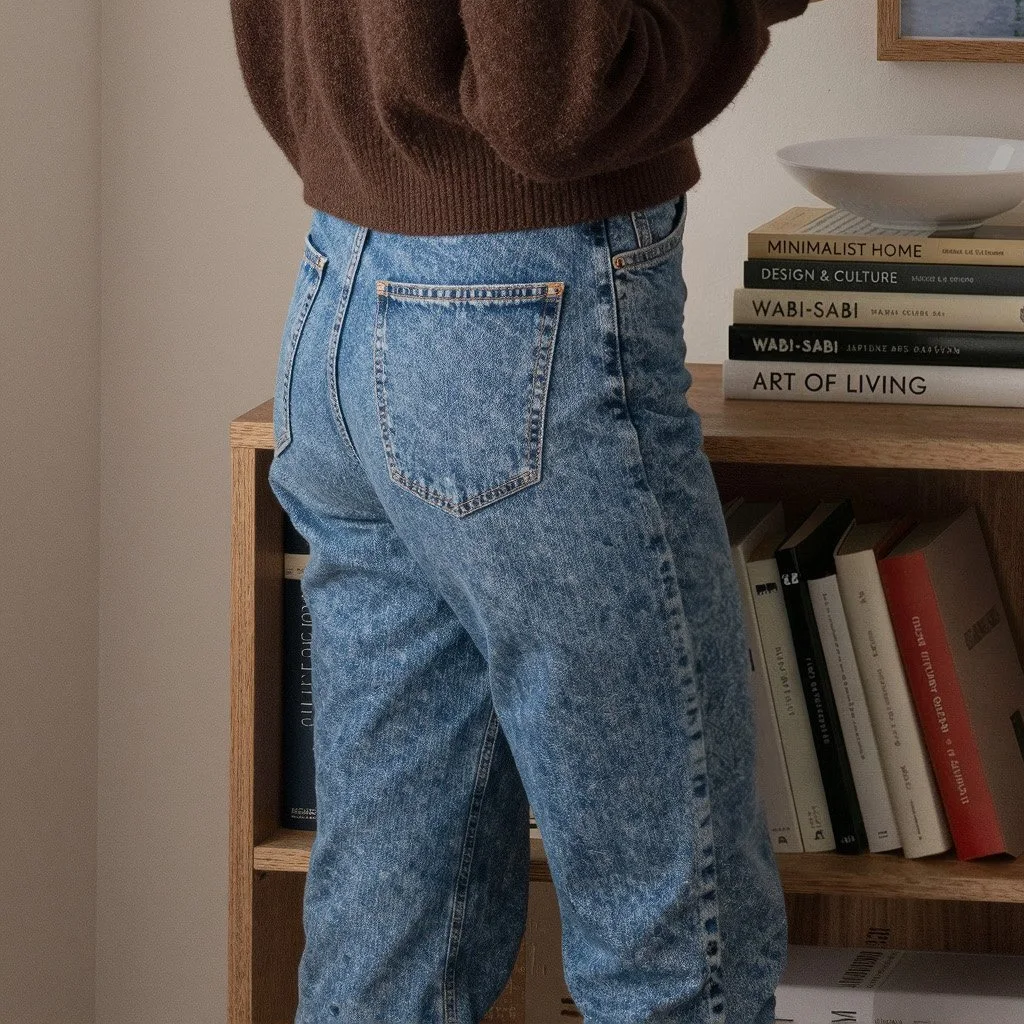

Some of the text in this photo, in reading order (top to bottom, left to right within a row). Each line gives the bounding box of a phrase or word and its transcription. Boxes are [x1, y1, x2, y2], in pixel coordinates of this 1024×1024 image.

[768, 240, 922, 258] MINIMALIST HOME
[761, 268, 815, 281] DESIGN
[819, 269, 830, 282] &
[834, 270, 898, 284] CULTURE
[752, 300, 858, 319] WABI-SABI
[752, 337, 838, 354] WABI-SABI
[752, 372, 927, 395] ART OF LIVING
